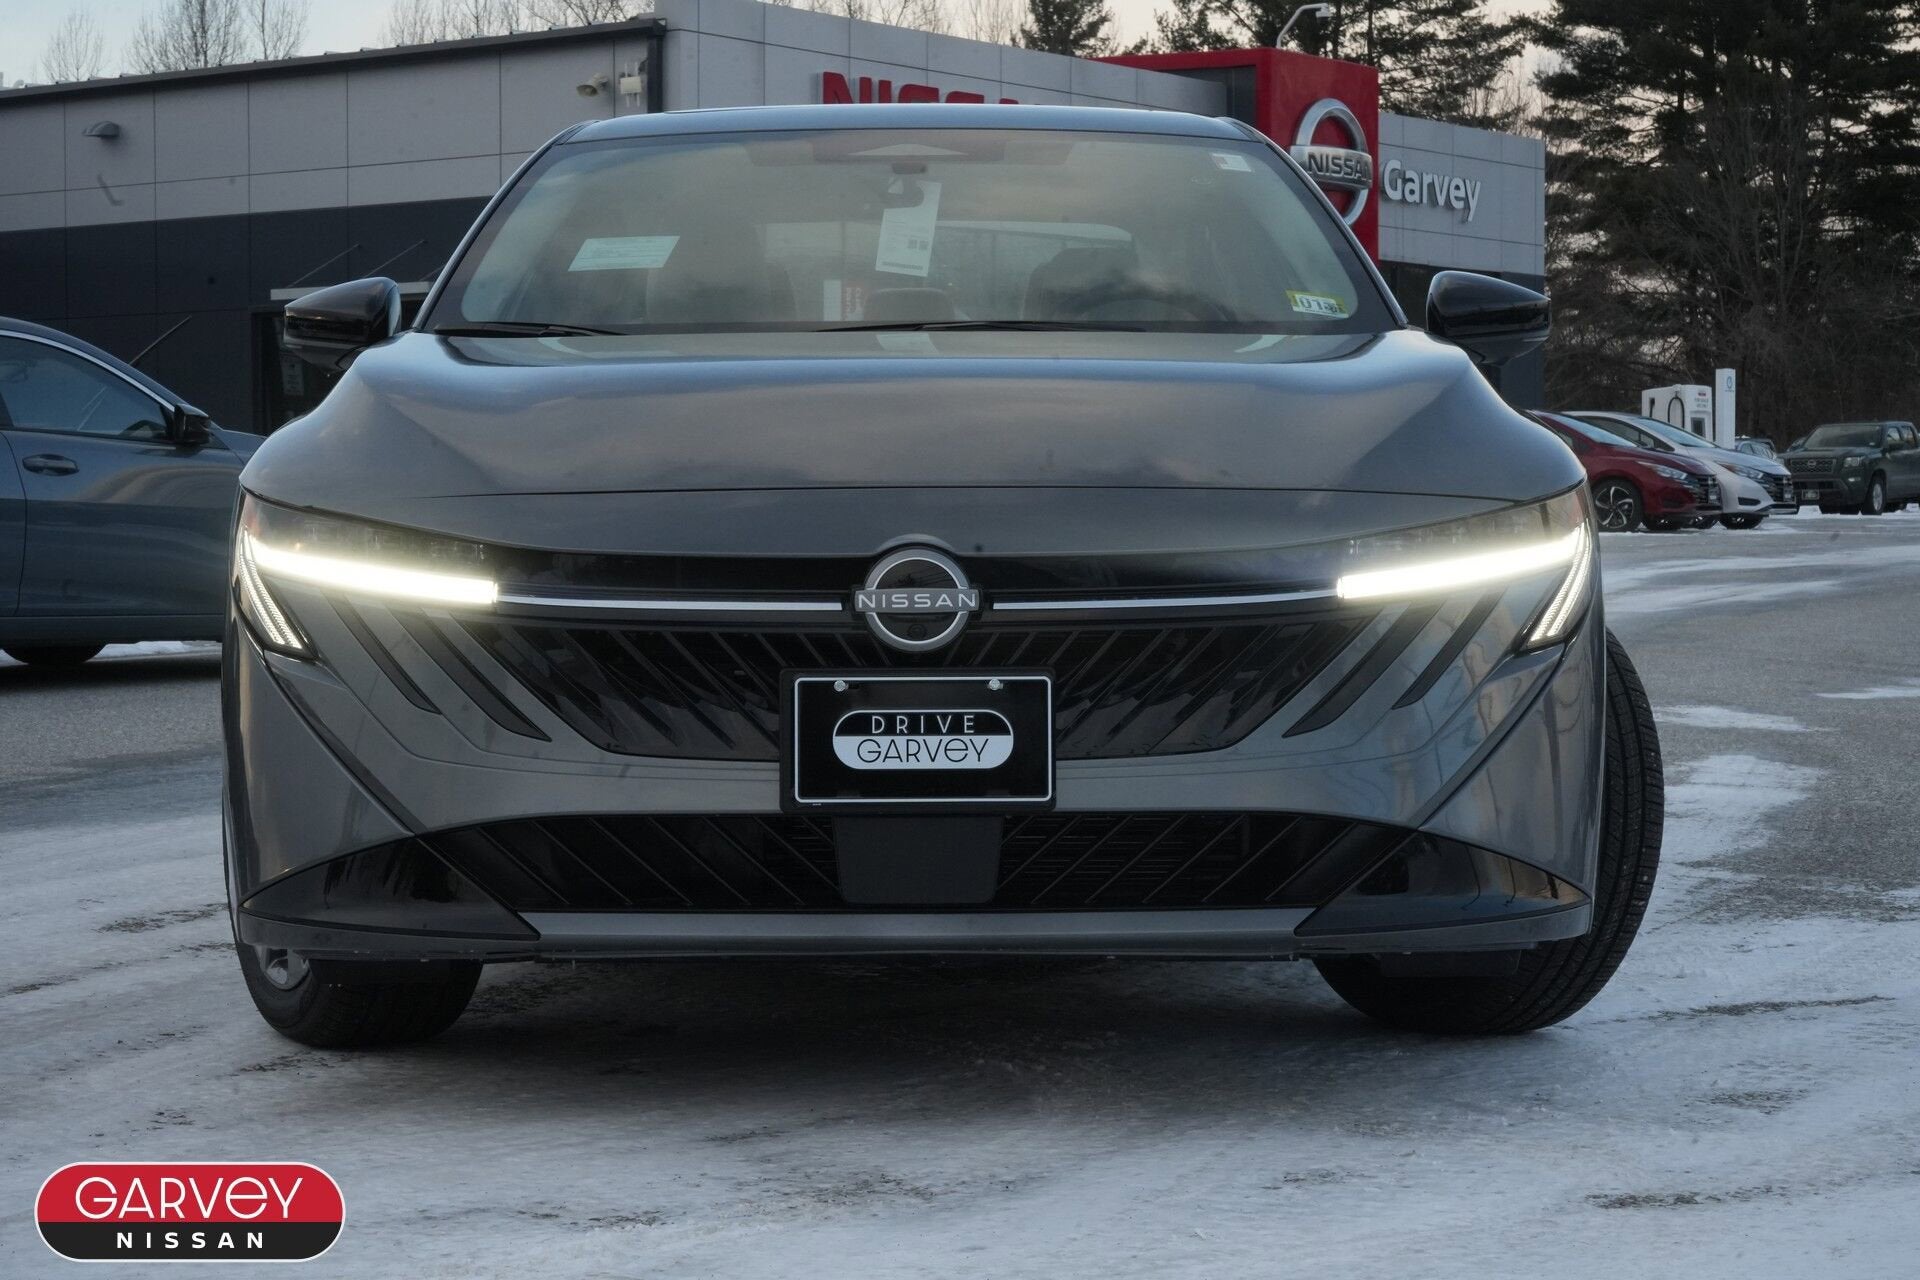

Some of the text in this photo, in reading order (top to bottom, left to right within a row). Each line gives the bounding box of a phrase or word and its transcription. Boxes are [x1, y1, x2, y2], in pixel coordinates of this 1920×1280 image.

[1382, 158, 1482, 223] Garvey
[857, 592, 977, 609] NISSAN
[871, 715, 975, 734] DRIVE
[856, 738, 989, 763] GARVEY
